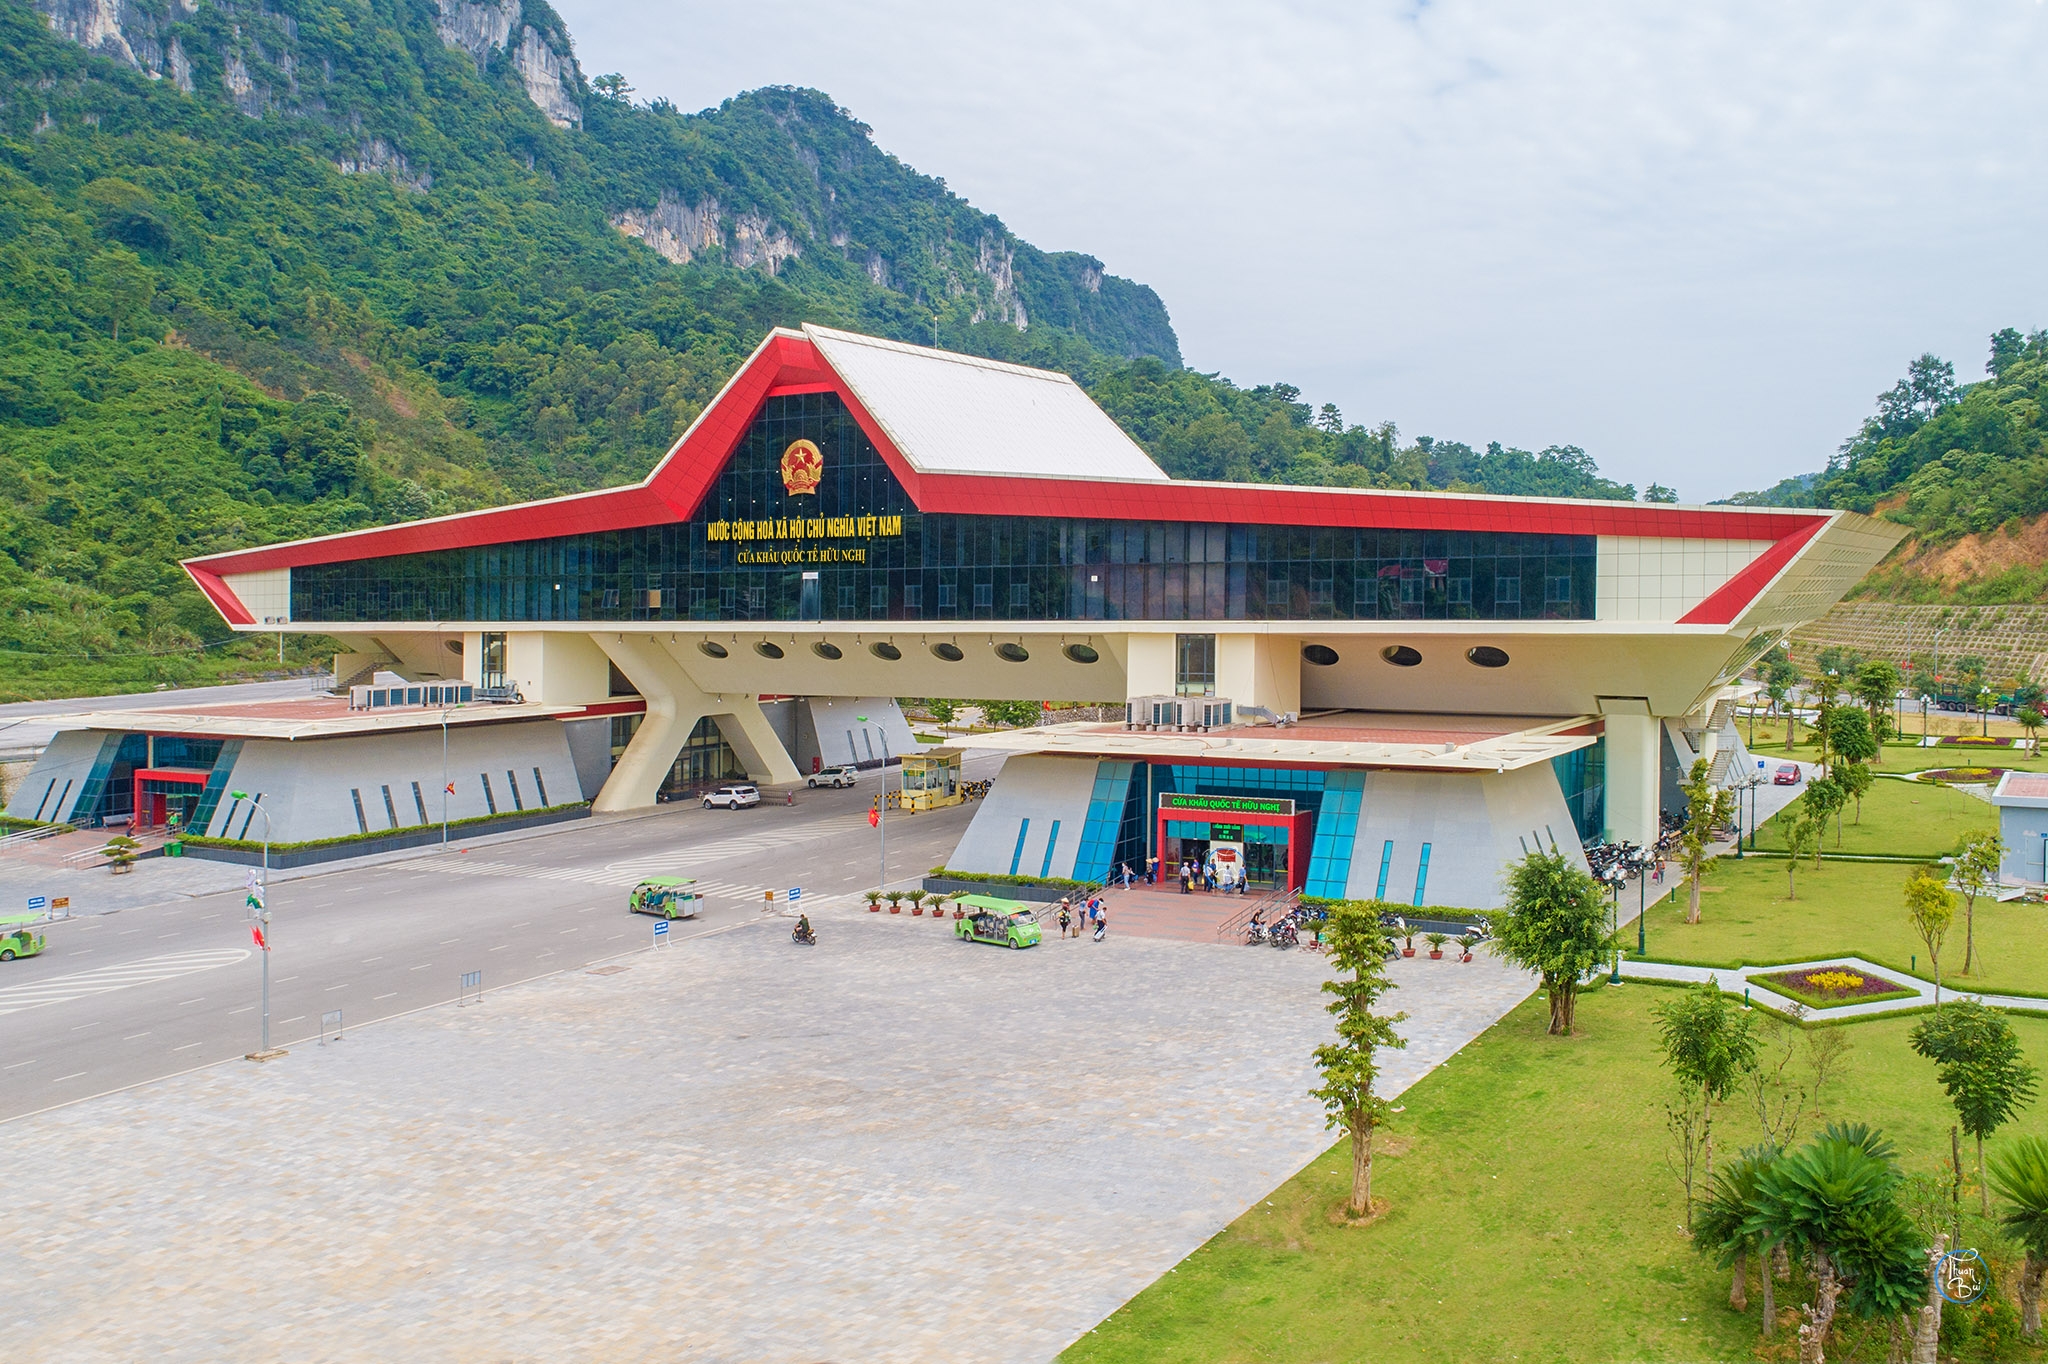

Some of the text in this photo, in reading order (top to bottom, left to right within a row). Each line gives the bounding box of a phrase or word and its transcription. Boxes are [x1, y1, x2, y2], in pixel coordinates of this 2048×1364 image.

[707, 512, 902, 545] NƯỚC CỘNG HOÀ XÃ HỘI CHỦ NGHĨA VIỆT NAM
[737, 544, 866, 565] CỬA KHẨU QUỐC TẾ HỮU NGHỊ
[1259, 802, 1280, 813] NGHỊ
